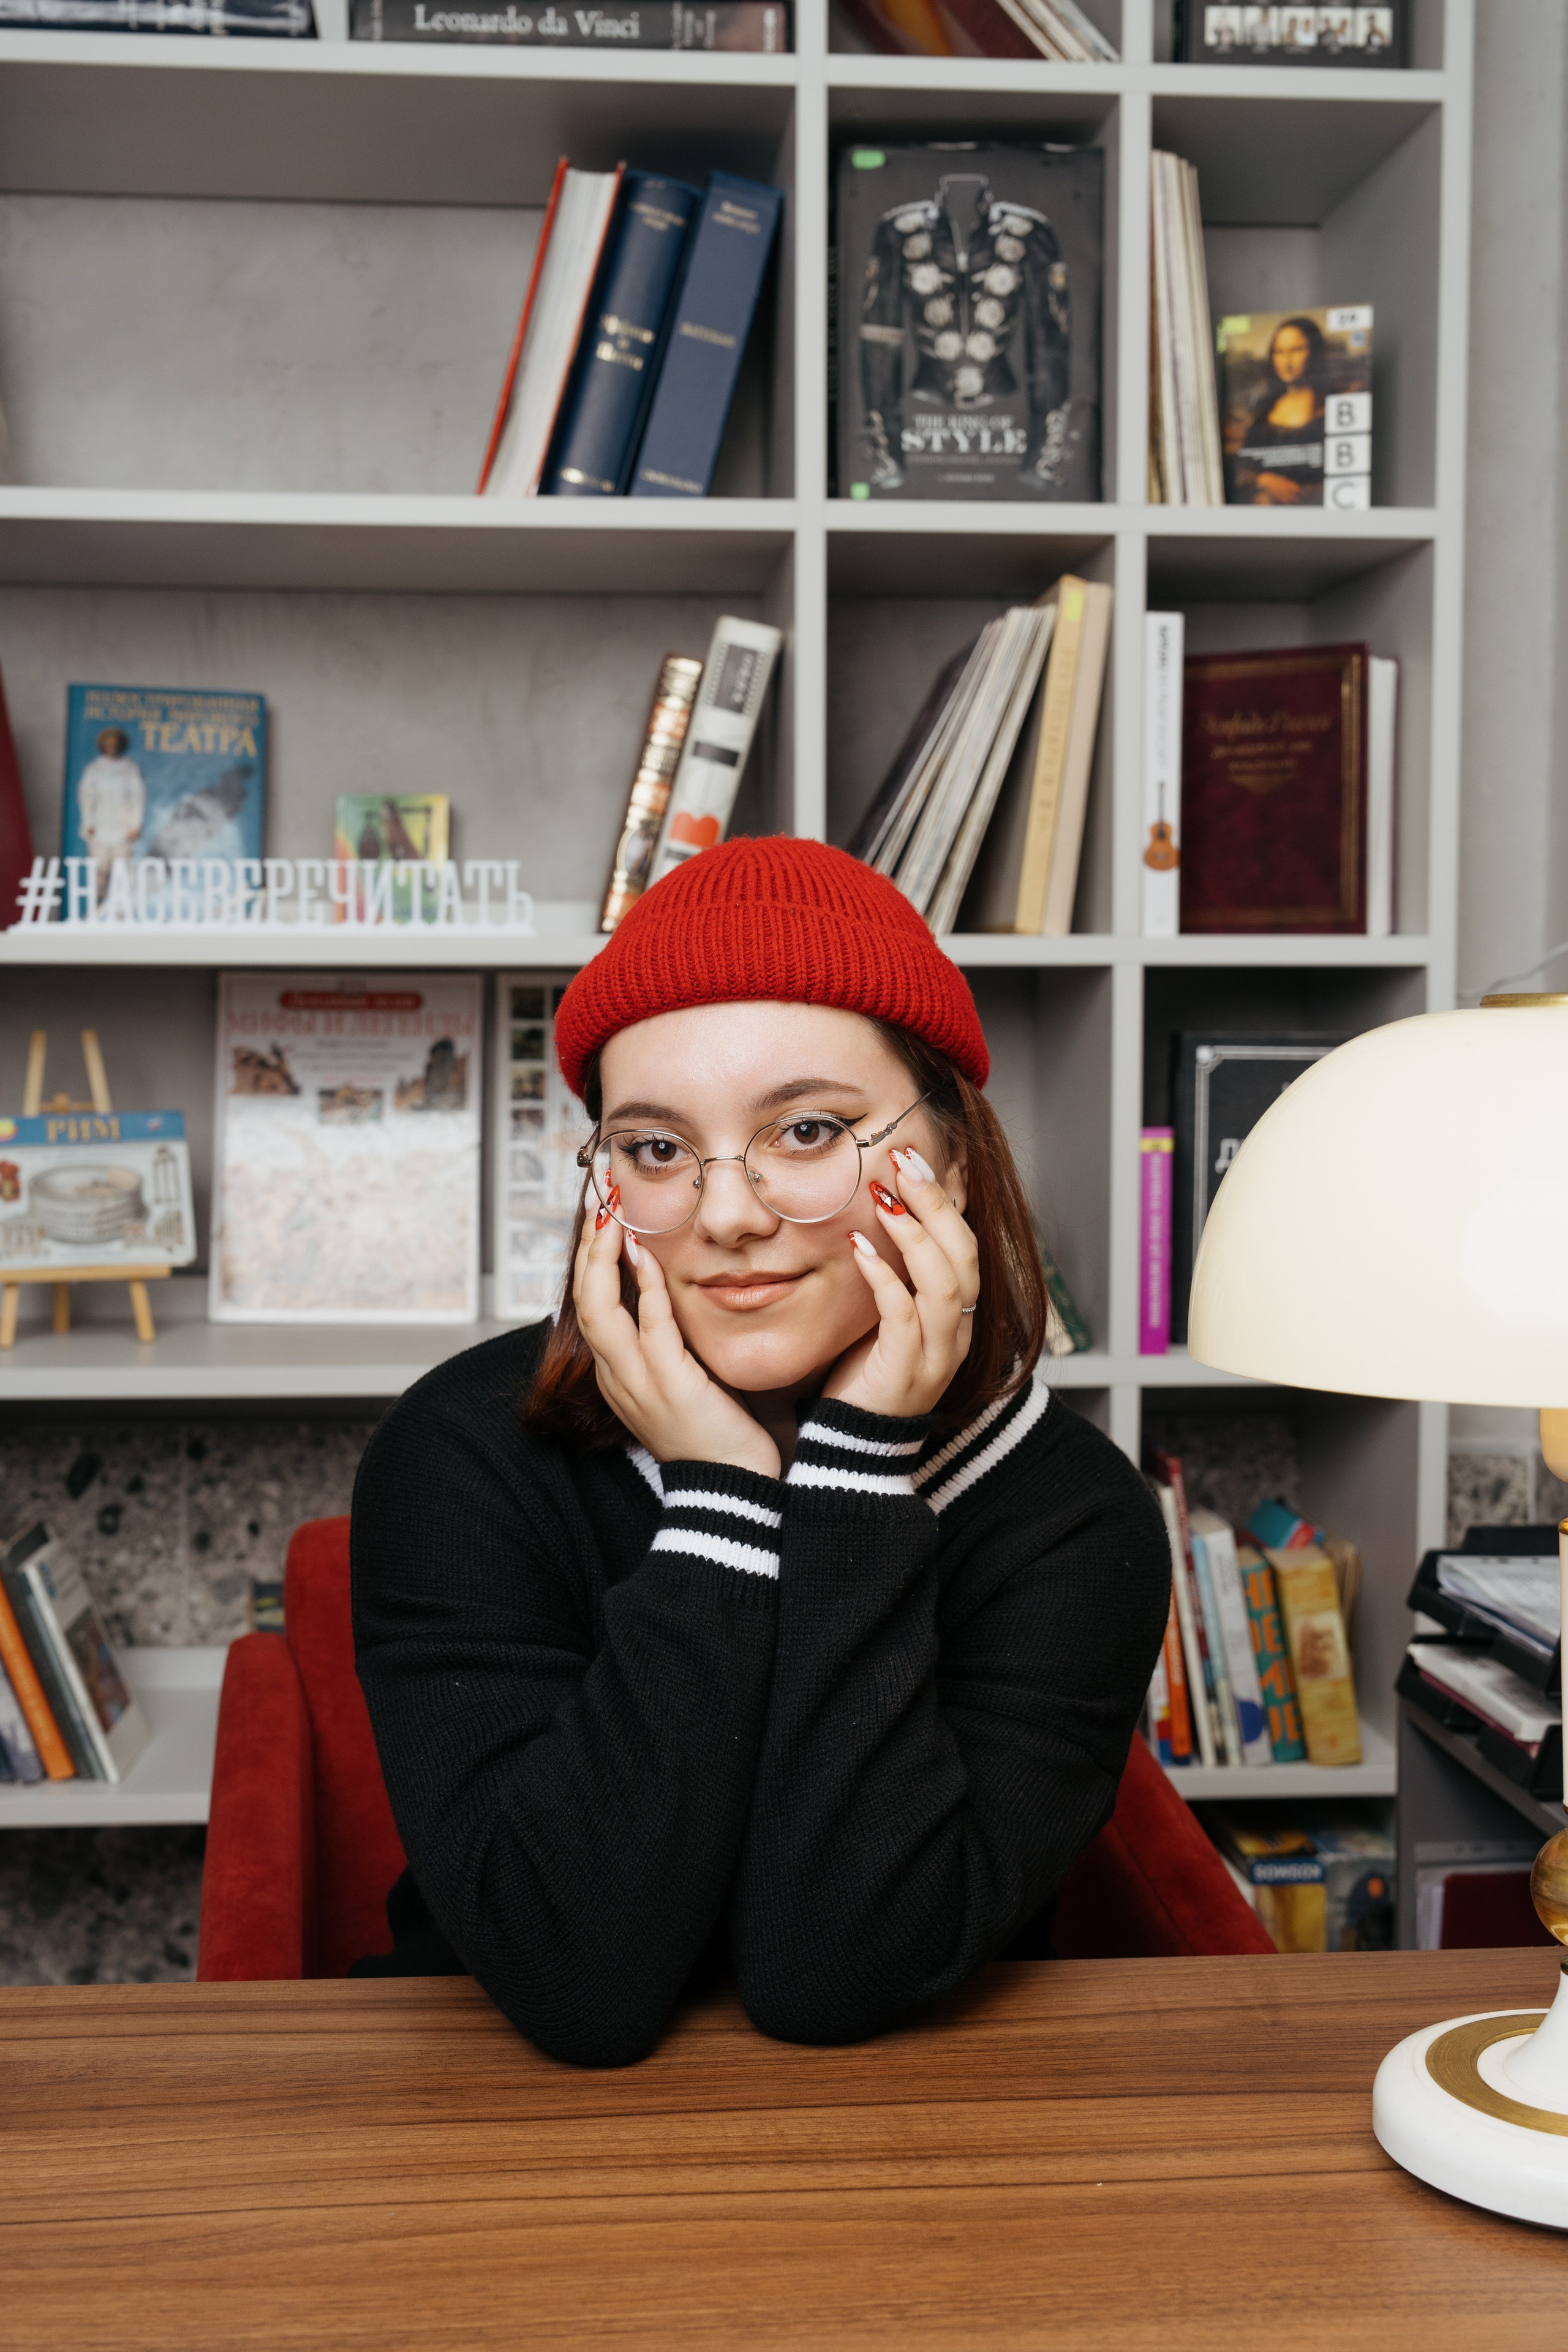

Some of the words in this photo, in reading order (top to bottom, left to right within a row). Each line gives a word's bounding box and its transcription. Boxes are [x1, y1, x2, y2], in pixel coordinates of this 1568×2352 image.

[413, 3, 533, 35] Leonardo
[537, 6, 569, 36] da
[573, 9, 640, 39] Vinci
[901, 428, 1027, 453] STYLE
[139, 720, 257, 757] ТЕАТРА
